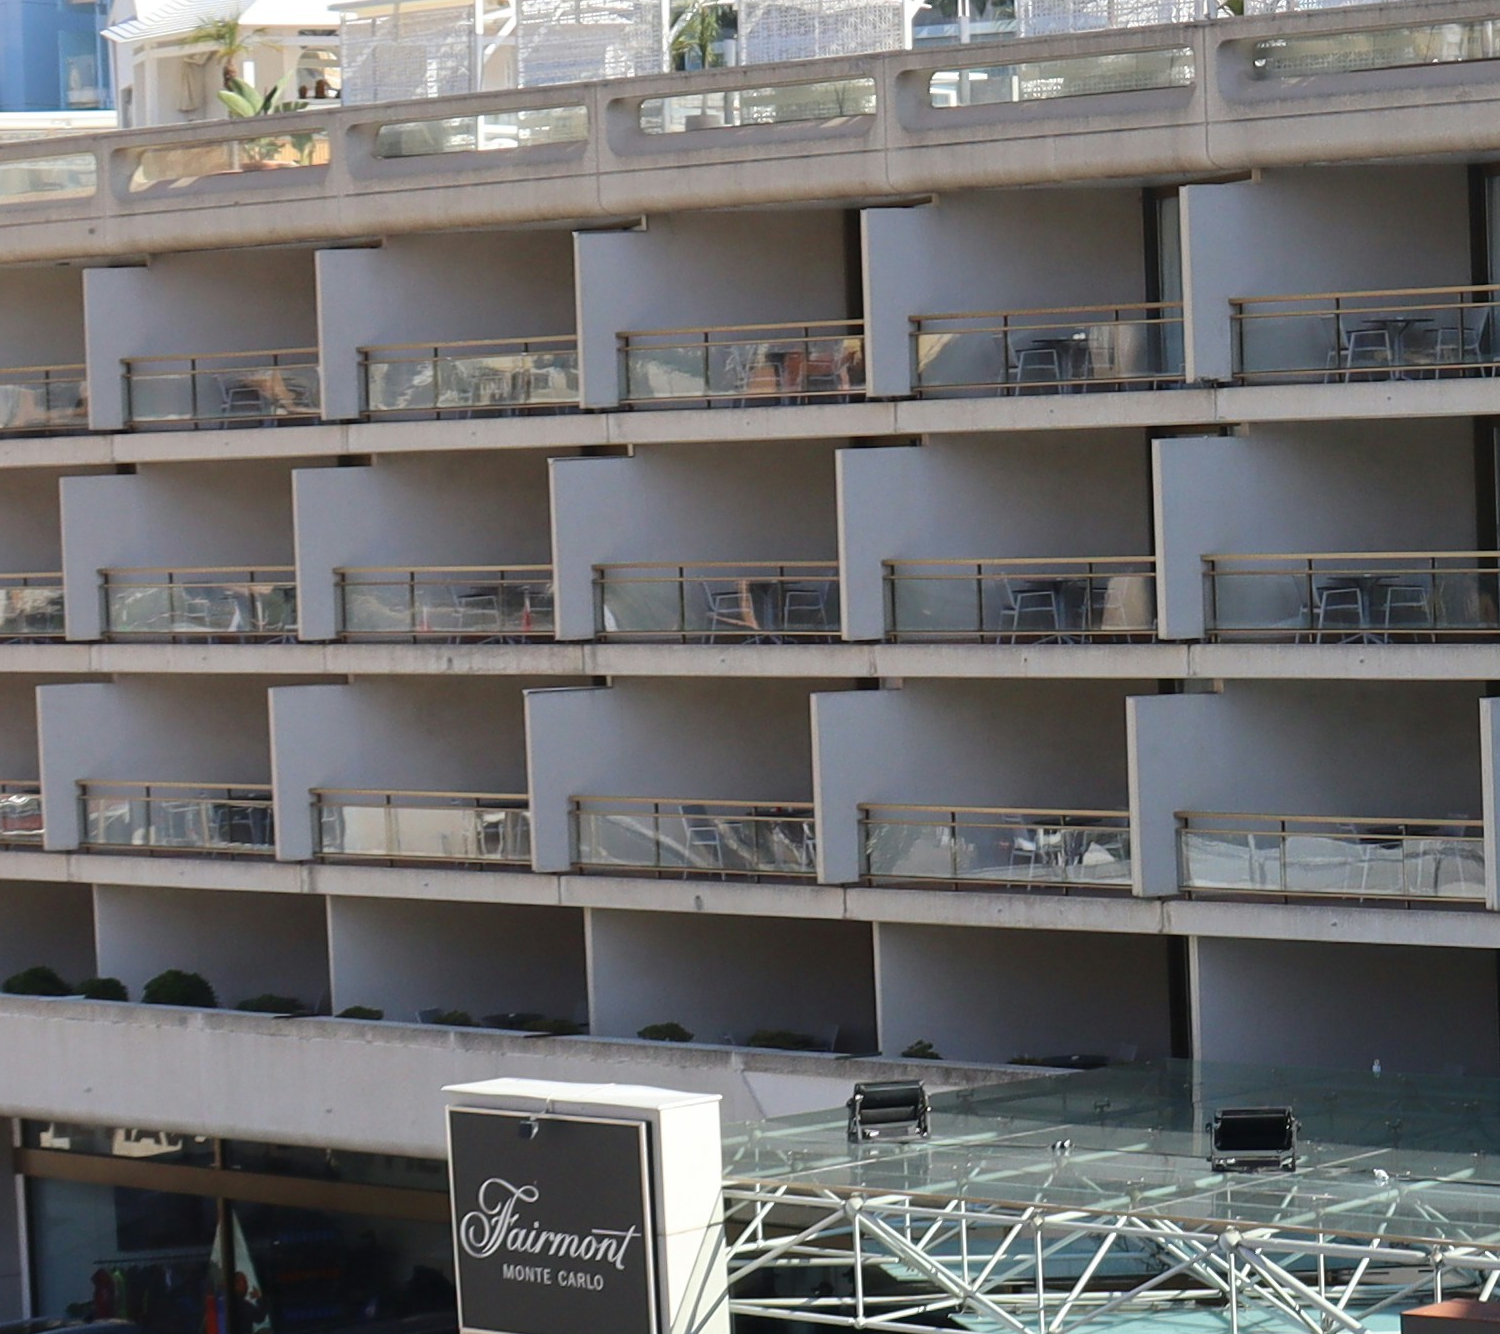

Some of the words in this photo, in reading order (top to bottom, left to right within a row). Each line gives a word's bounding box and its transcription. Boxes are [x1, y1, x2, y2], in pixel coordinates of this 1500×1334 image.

[459, 1177, 642, 1271] Fairmont
[502, 1263, 552, 1285] MONTE
[557, 1270, 605, 1291] CARLO
